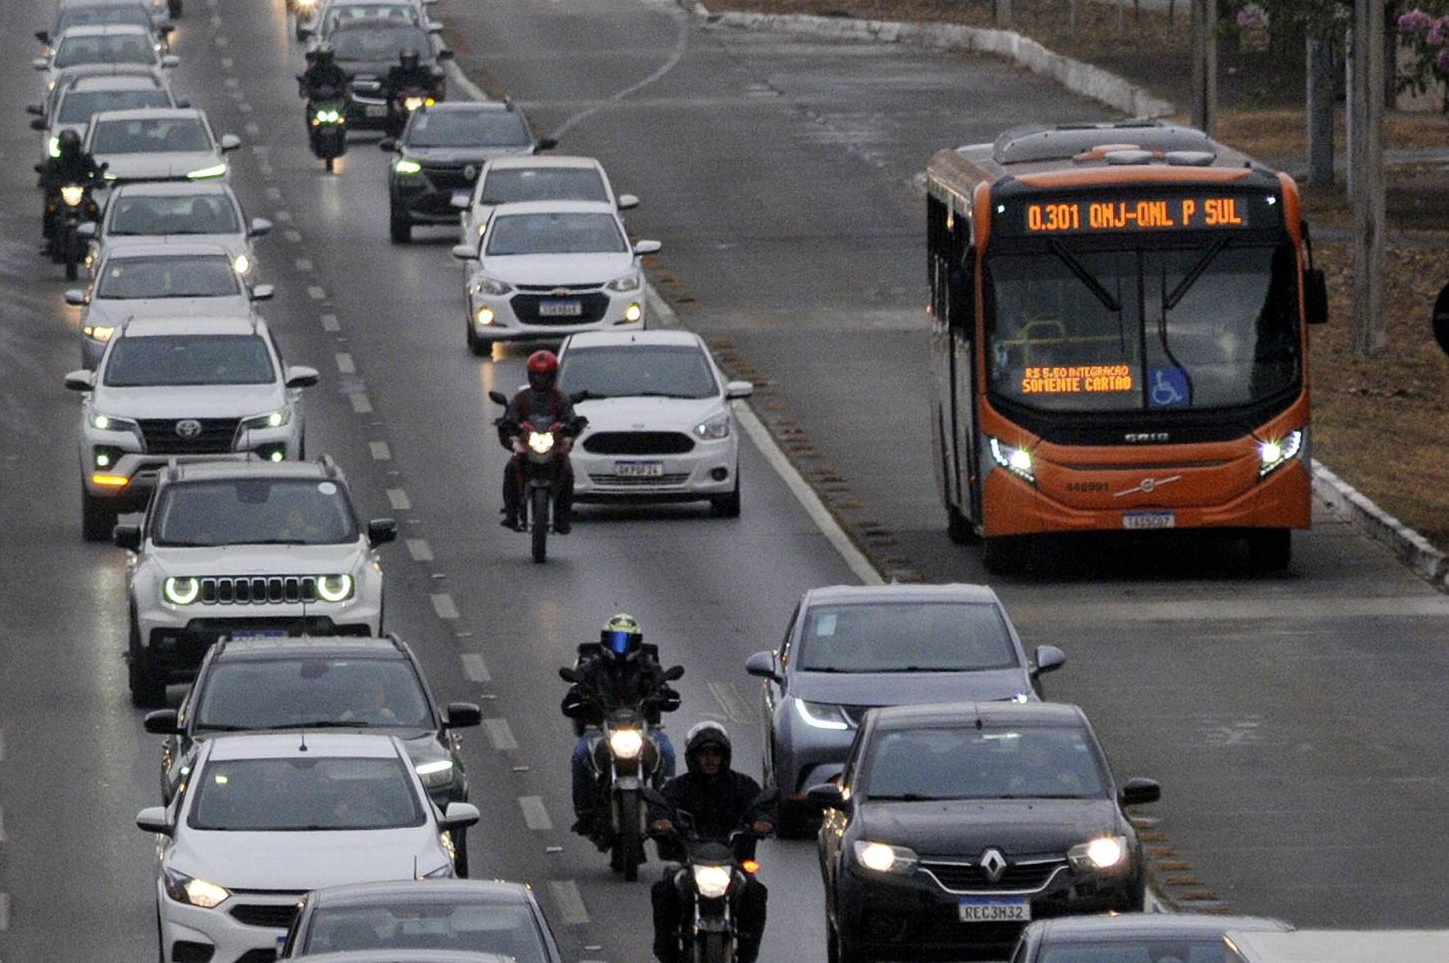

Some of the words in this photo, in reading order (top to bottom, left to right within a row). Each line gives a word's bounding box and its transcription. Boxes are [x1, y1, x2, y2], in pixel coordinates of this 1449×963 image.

[1028, 204, 1079, 230] 0.301
[1182, 199, 1195, 226] P
[1204, 198, 1242, 225] SUL
[1022, 378, 1081, 392] SOMENTE
[1085, 376, 1132, 392] CARTAO
[965, 905, 1023, 920] REC3H32
